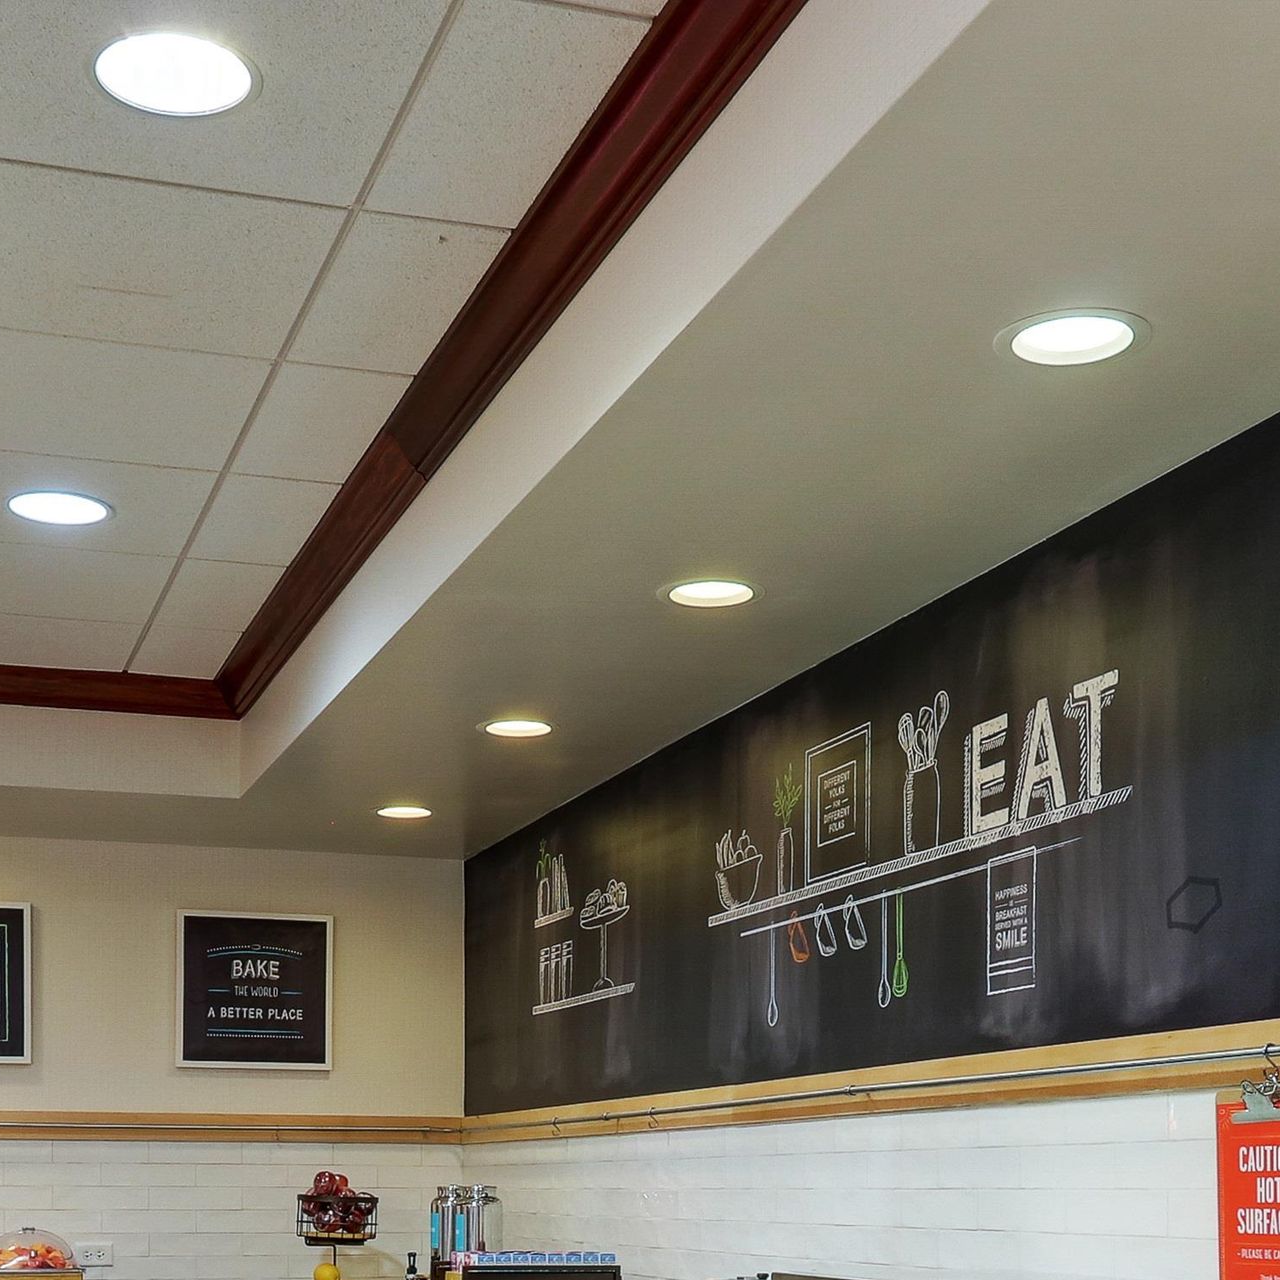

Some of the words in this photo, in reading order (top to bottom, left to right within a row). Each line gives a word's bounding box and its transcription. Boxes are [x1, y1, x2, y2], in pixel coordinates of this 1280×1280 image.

[965, 669, 1119, 836] EAT
[823, 770, 850, 789] DIFFERENT
[823, 805, 850, 824] DIFFERENT
[994, 884, 1028, 901] HAPPINESS
[995, 905, 1027, 921] BREAKFAST
[995, 926, 1027, 951] SMILE
[231, 959, 280, 980] BAKE
[234, 985, 248, 996] THE
[250, 986, 279, 997] WORLD
[207, 1006, 216, 1018] A
[220, 1007, 263, 1019] BETTER
[268, 1008, 303, 1020] PLACE
